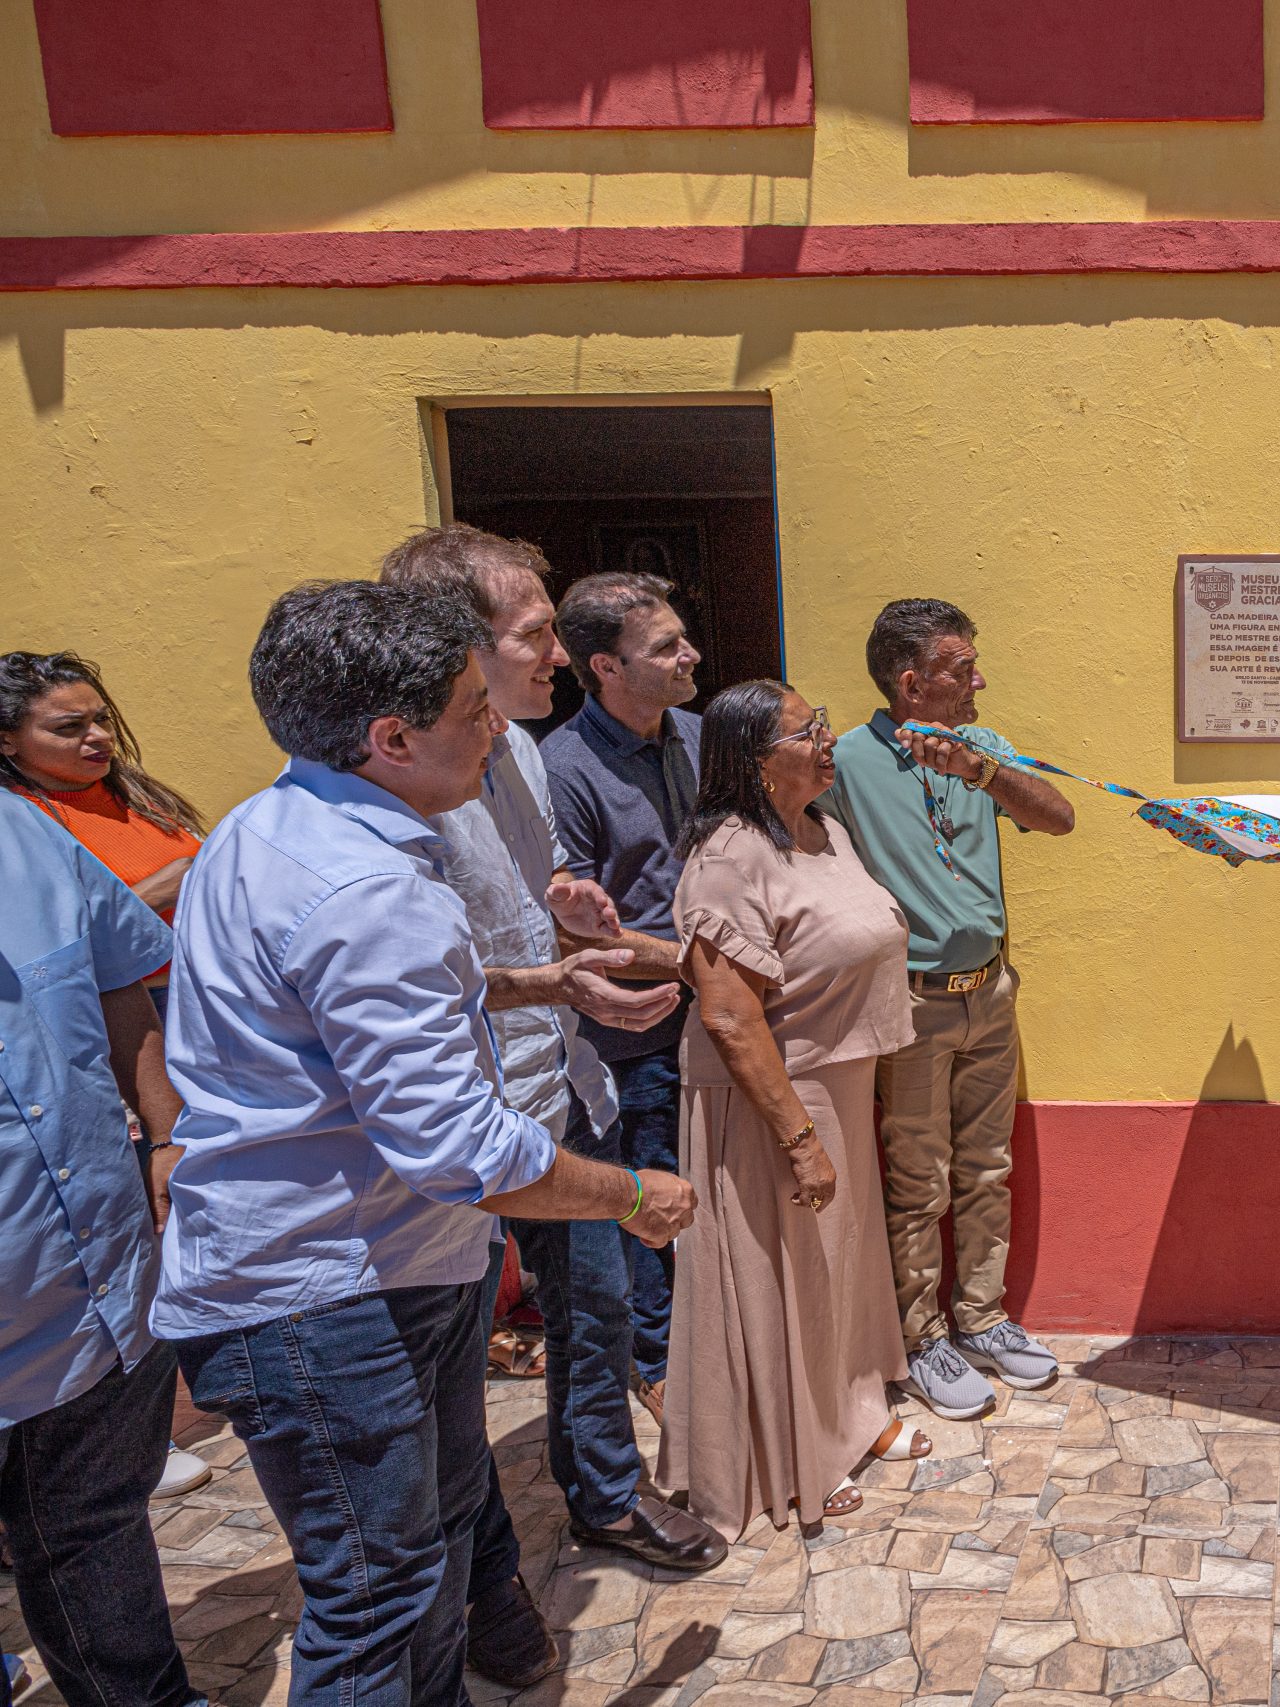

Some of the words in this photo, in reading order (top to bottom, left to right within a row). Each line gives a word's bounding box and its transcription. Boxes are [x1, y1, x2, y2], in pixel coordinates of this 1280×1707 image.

[1241, 575, 1279, 584] MUSEU
[1198, 583, 1228, 592] MUSEUS
[1273, 644, 1278, 652] É
